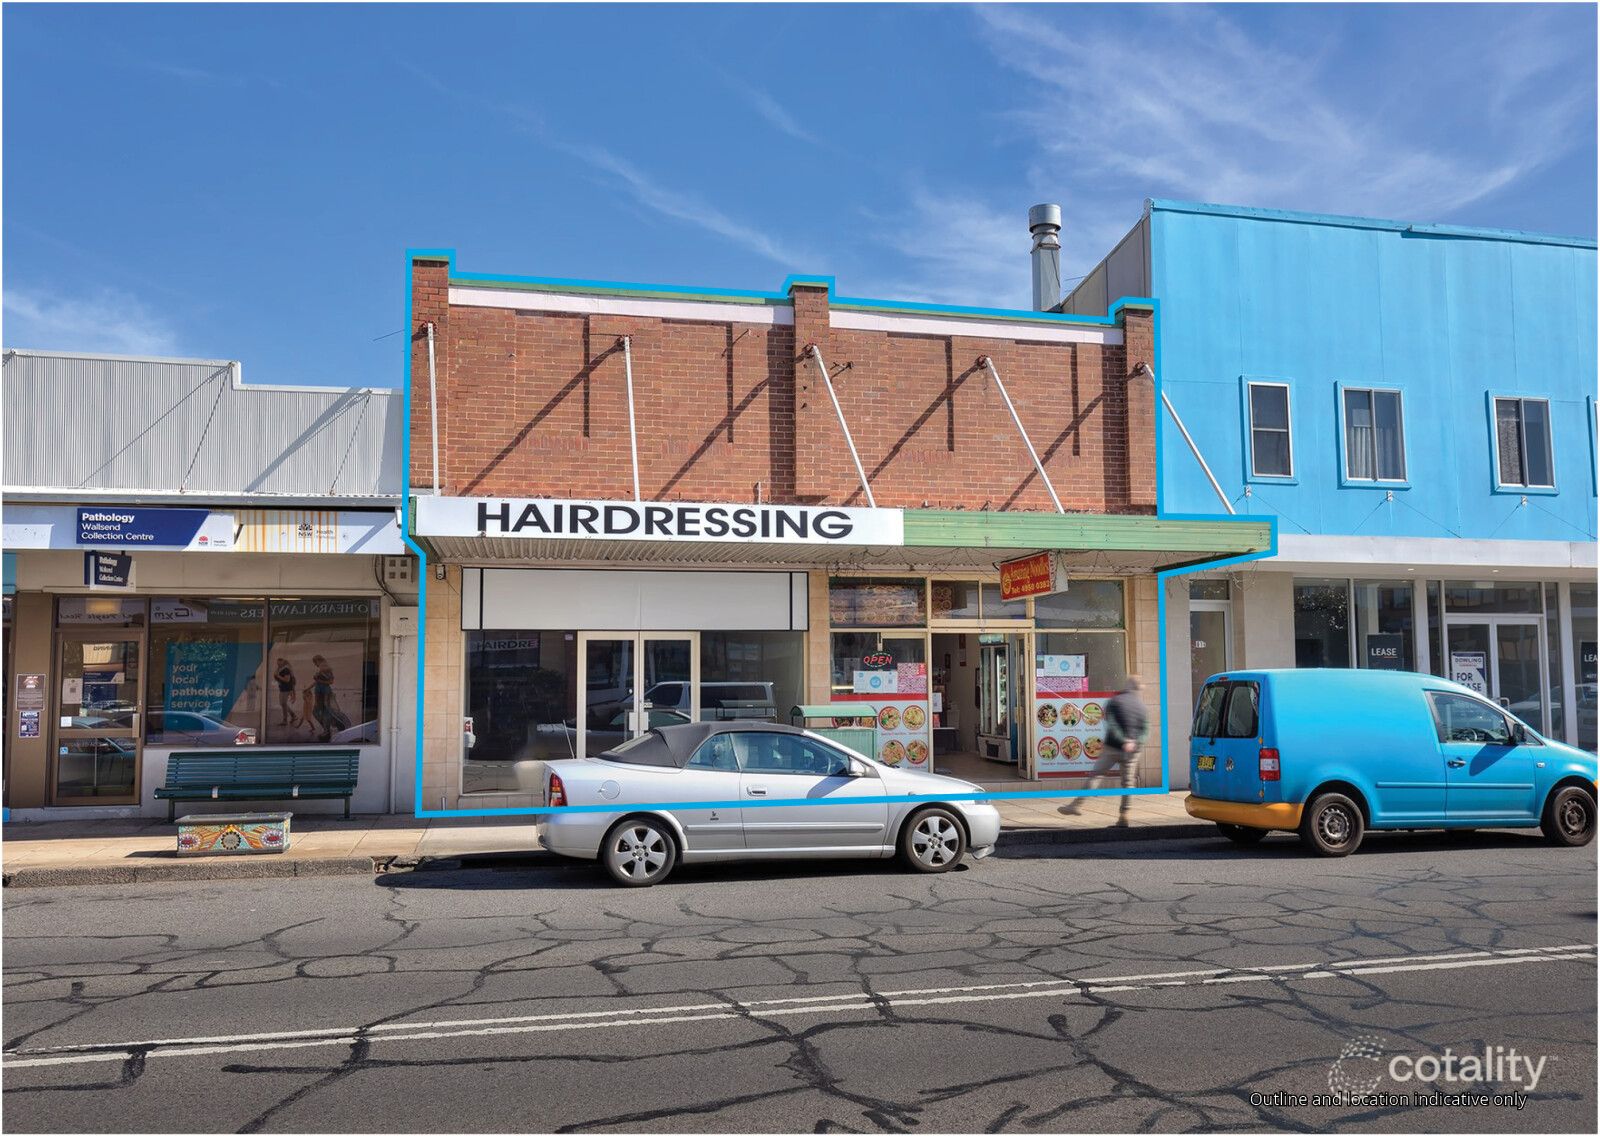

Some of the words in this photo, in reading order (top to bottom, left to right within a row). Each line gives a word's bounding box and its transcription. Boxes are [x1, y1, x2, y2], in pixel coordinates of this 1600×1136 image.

[82, 512, 135, 523] Pathology
[477, 502, 854, 539] HAIRDRESSING
[82, 523, 121, 531] Wallsend
[81, 532, 124, 541] Collection
[125, 533, 154, 541] Centre
[1371, 648, 1397, 656] LEASE
[863, 655, 893, 665] OPEN
[172, 662, 197, 674] your
[172, 674, 199, 684] local
[1456, 672, 1473, 681] FOR
[171, 686, 230, 698] pathology
[171, 699, 211, 709] service
